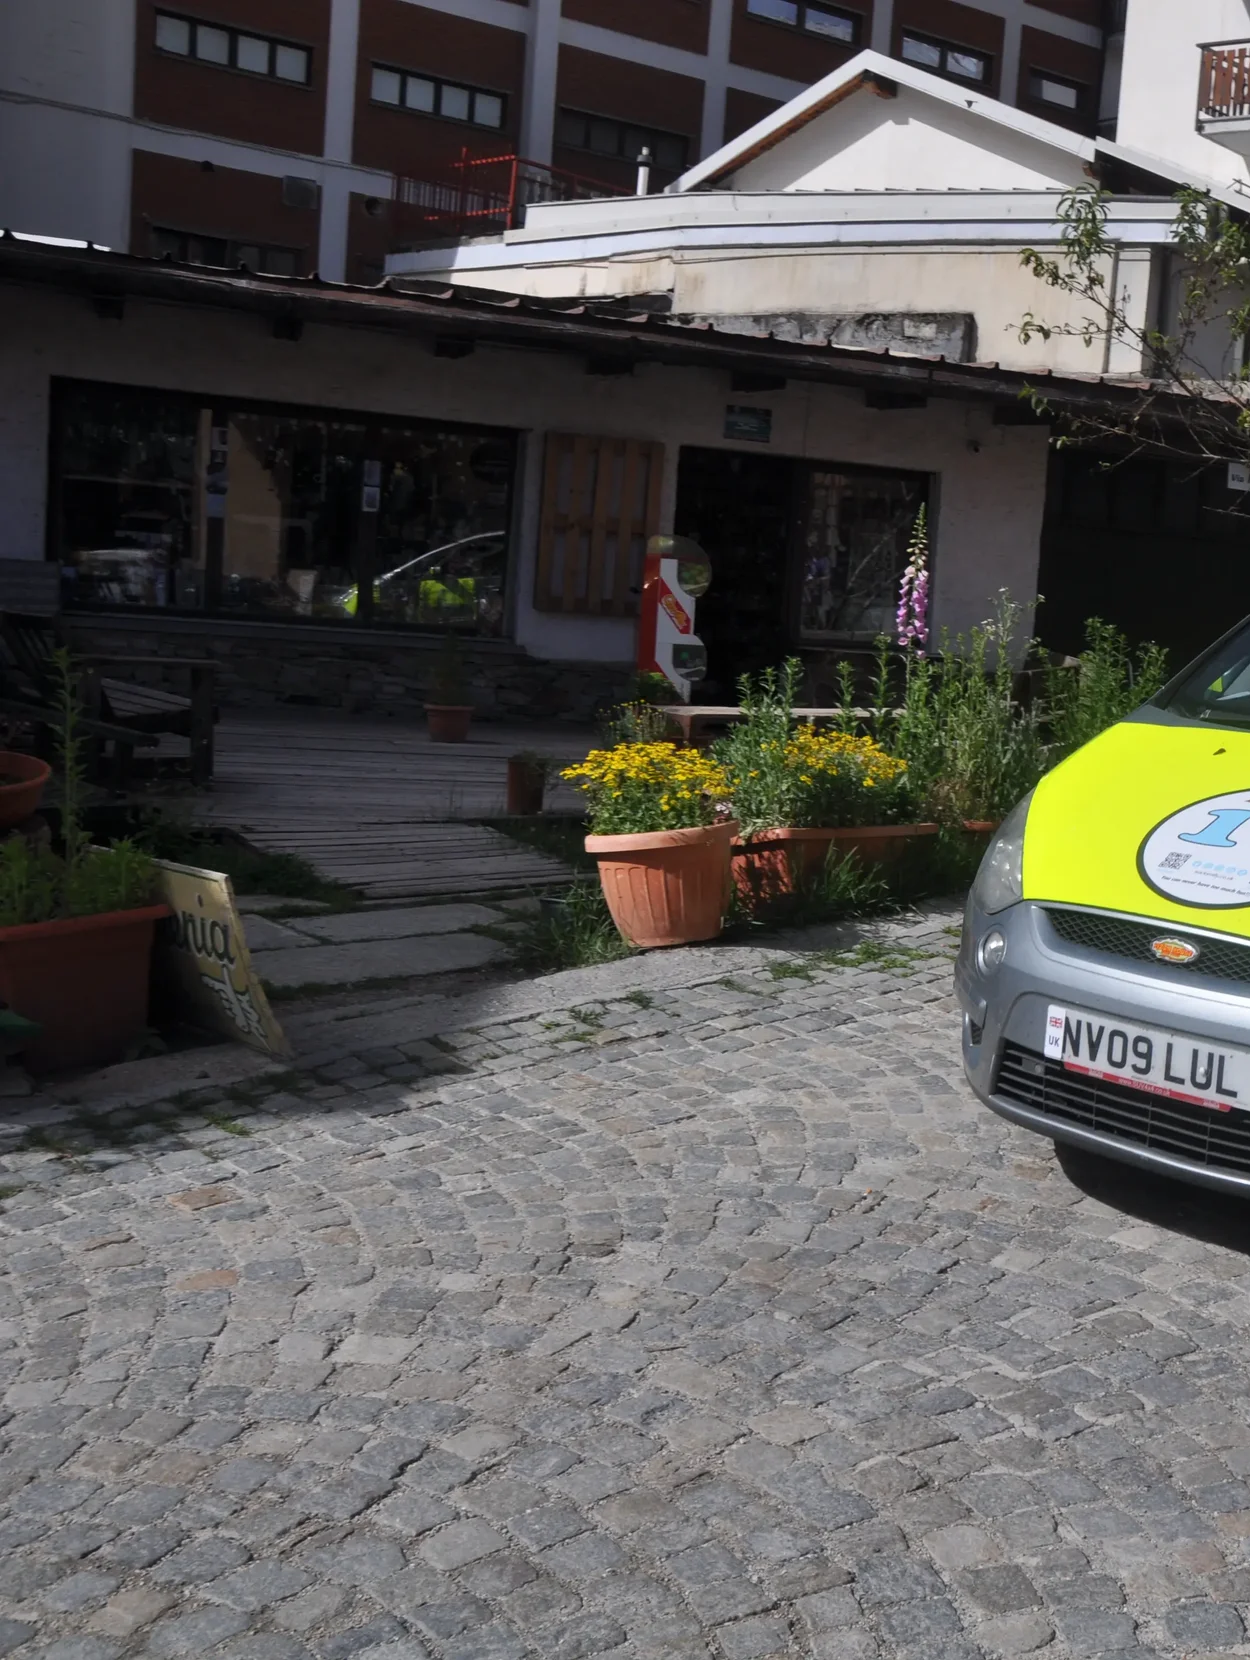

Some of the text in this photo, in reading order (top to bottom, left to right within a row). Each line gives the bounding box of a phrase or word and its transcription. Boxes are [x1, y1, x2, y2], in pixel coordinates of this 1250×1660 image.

[1048, 1034, 1061, 1048] UK
[1063, 1015, 1238, 1099] NV09 LUL
